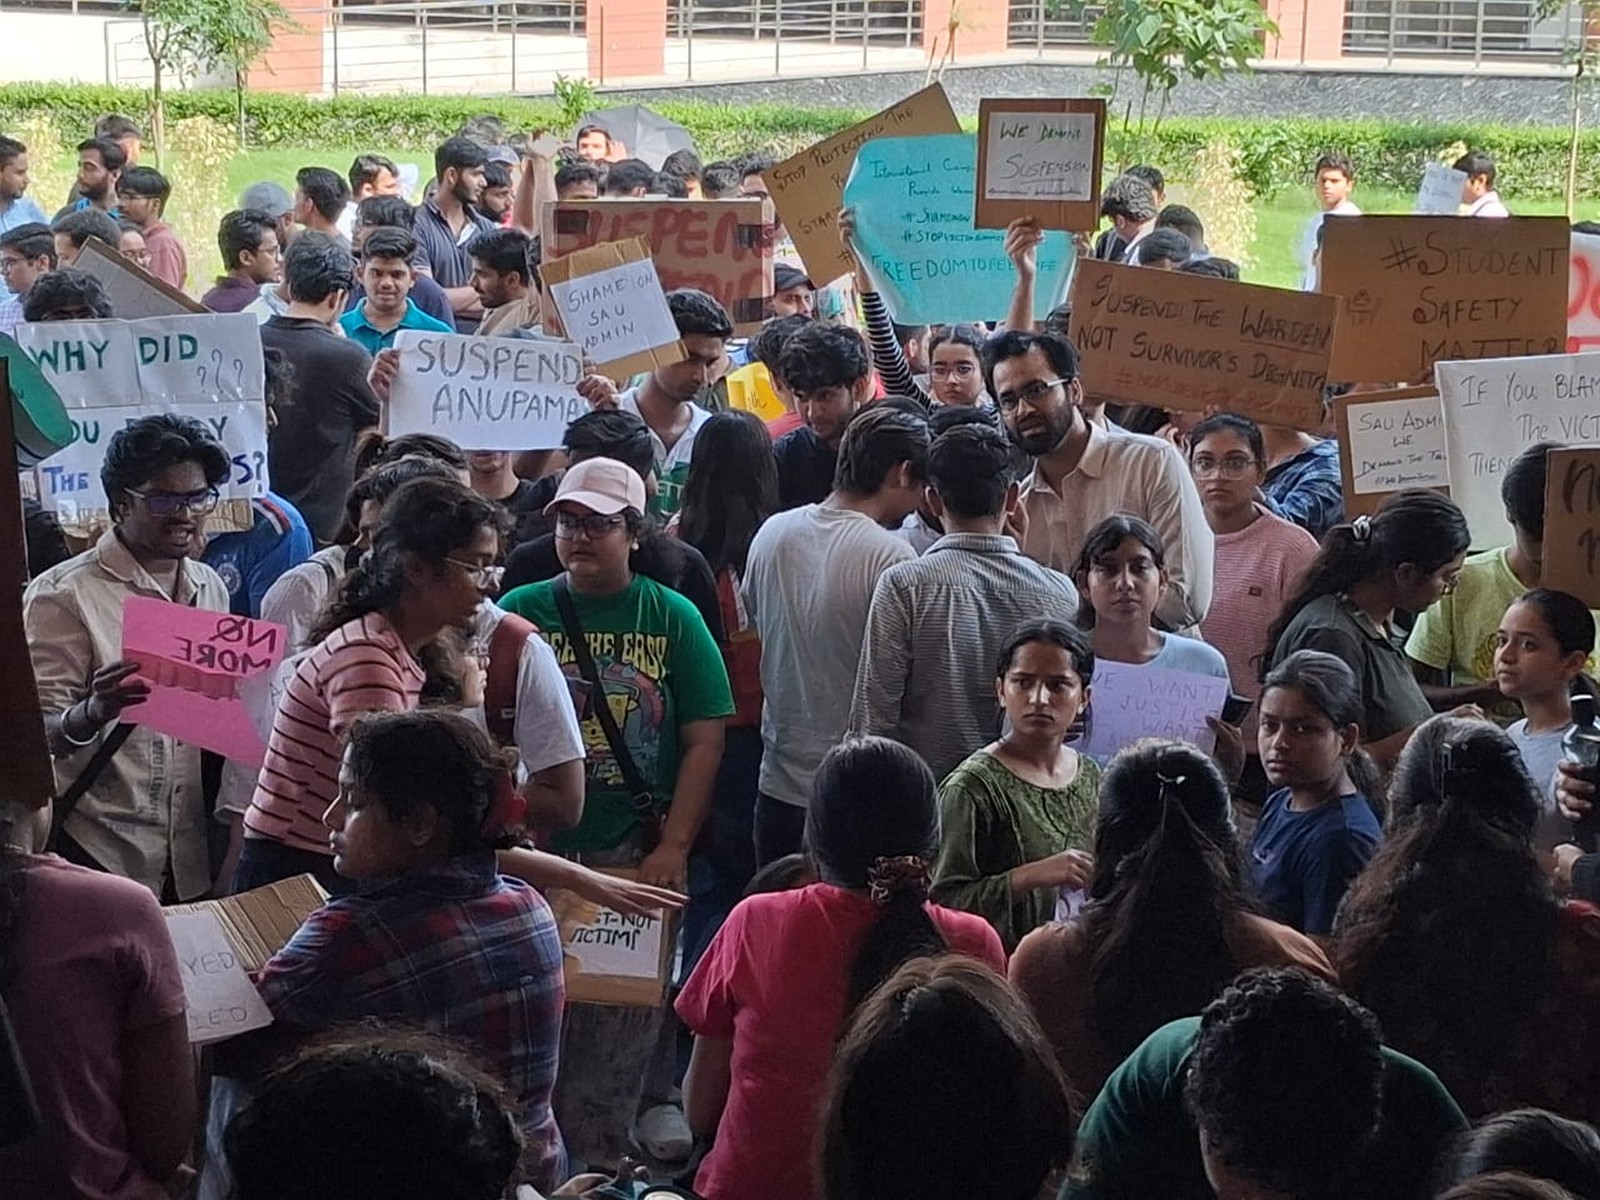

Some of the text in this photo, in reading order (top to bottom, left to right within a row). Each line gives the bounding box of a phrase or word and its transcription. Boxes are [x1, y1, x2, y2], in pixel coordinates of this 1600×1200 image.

[1000, 121, 1029, 139] WE
[773, 166, 806, 191] STOP
[1380, 231, 1566, 276] #STUDENT
[568, 278, 626, 312] SHAME
[637, 272, 653, 289] ON
[1412, 286, 1523, 328] SAFETY
[587, 303, 626, 327] SAU
[1191, 299, 1226, 328] THE
[1240, 306, 1331, 349] WARDEN
[584, 321, 635, 349] ADMIN
[1077, 326, 1118, 351] NOT
[1129, 331, 1240, 371] SURVIVOR'S
[28, 339, 110, 374] WHY
[139, 333, 198, 366] DID
[416, 338, 582, 385] SUSPEND
[432, 382, 580, 426] ANUPAMA
[1460, 375, 1489, 407] IF
[1357, 409, 1440, 432] SAU ADMI
[1517, 413, 1600, 442] The VICT
[42, 465, 89, 495] THE
[622, 632, 668, 680] EASY
[1149, 679, 1216, 701] WANT
